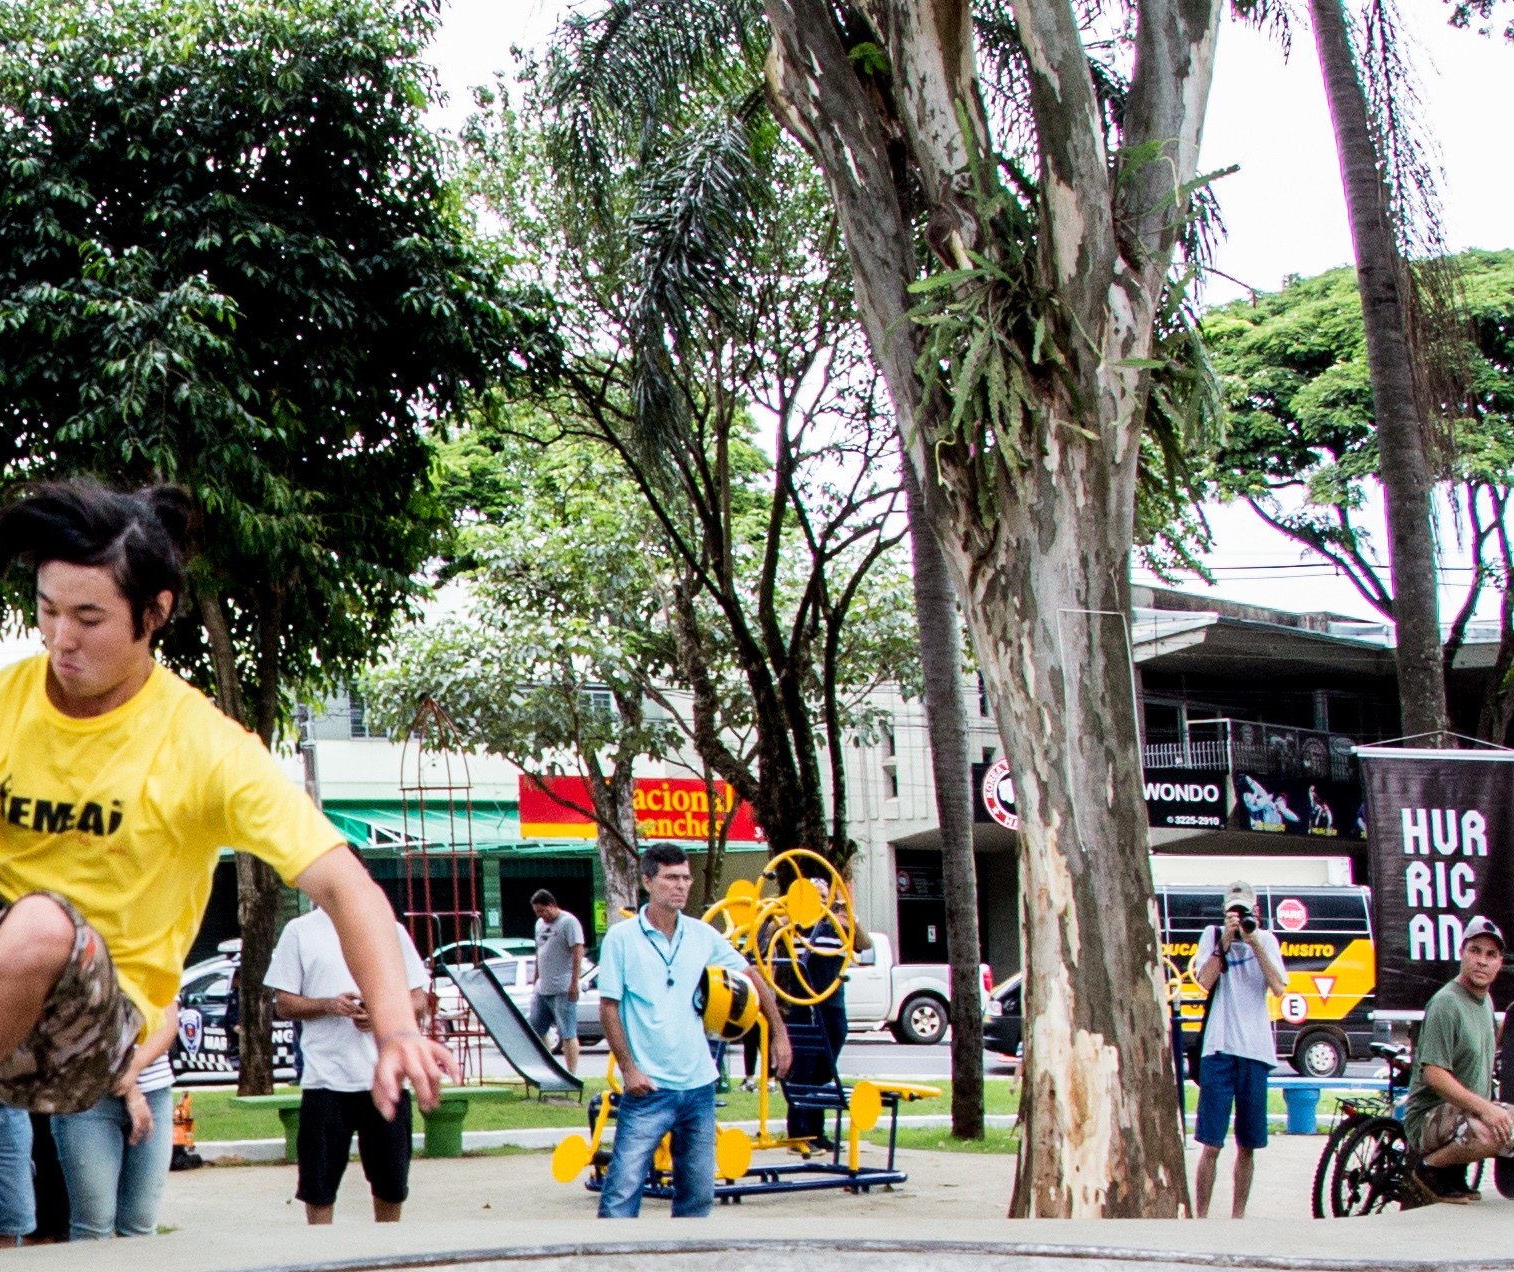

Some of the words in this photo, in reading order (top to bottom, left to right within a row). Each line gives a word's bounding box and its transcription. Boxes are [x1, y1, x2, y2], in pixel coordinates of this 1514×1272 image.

[632, 782, 734, 815] acional
[1143, 783, 1219, 803] WONDO
[634, 811, 725, 838] anches
[1401, 808, 1489, 857] HUR
[1405, 860, 1477, 909] RIC
[1279, 909, 1304, 920] PARE
[1161, 942, 1199, 957] DUCA
[1280, 942, 1335, 958] ÂNSITO
[1408, 913, 1464, 962] AN
[1289, 998, 1299, 1017] E
